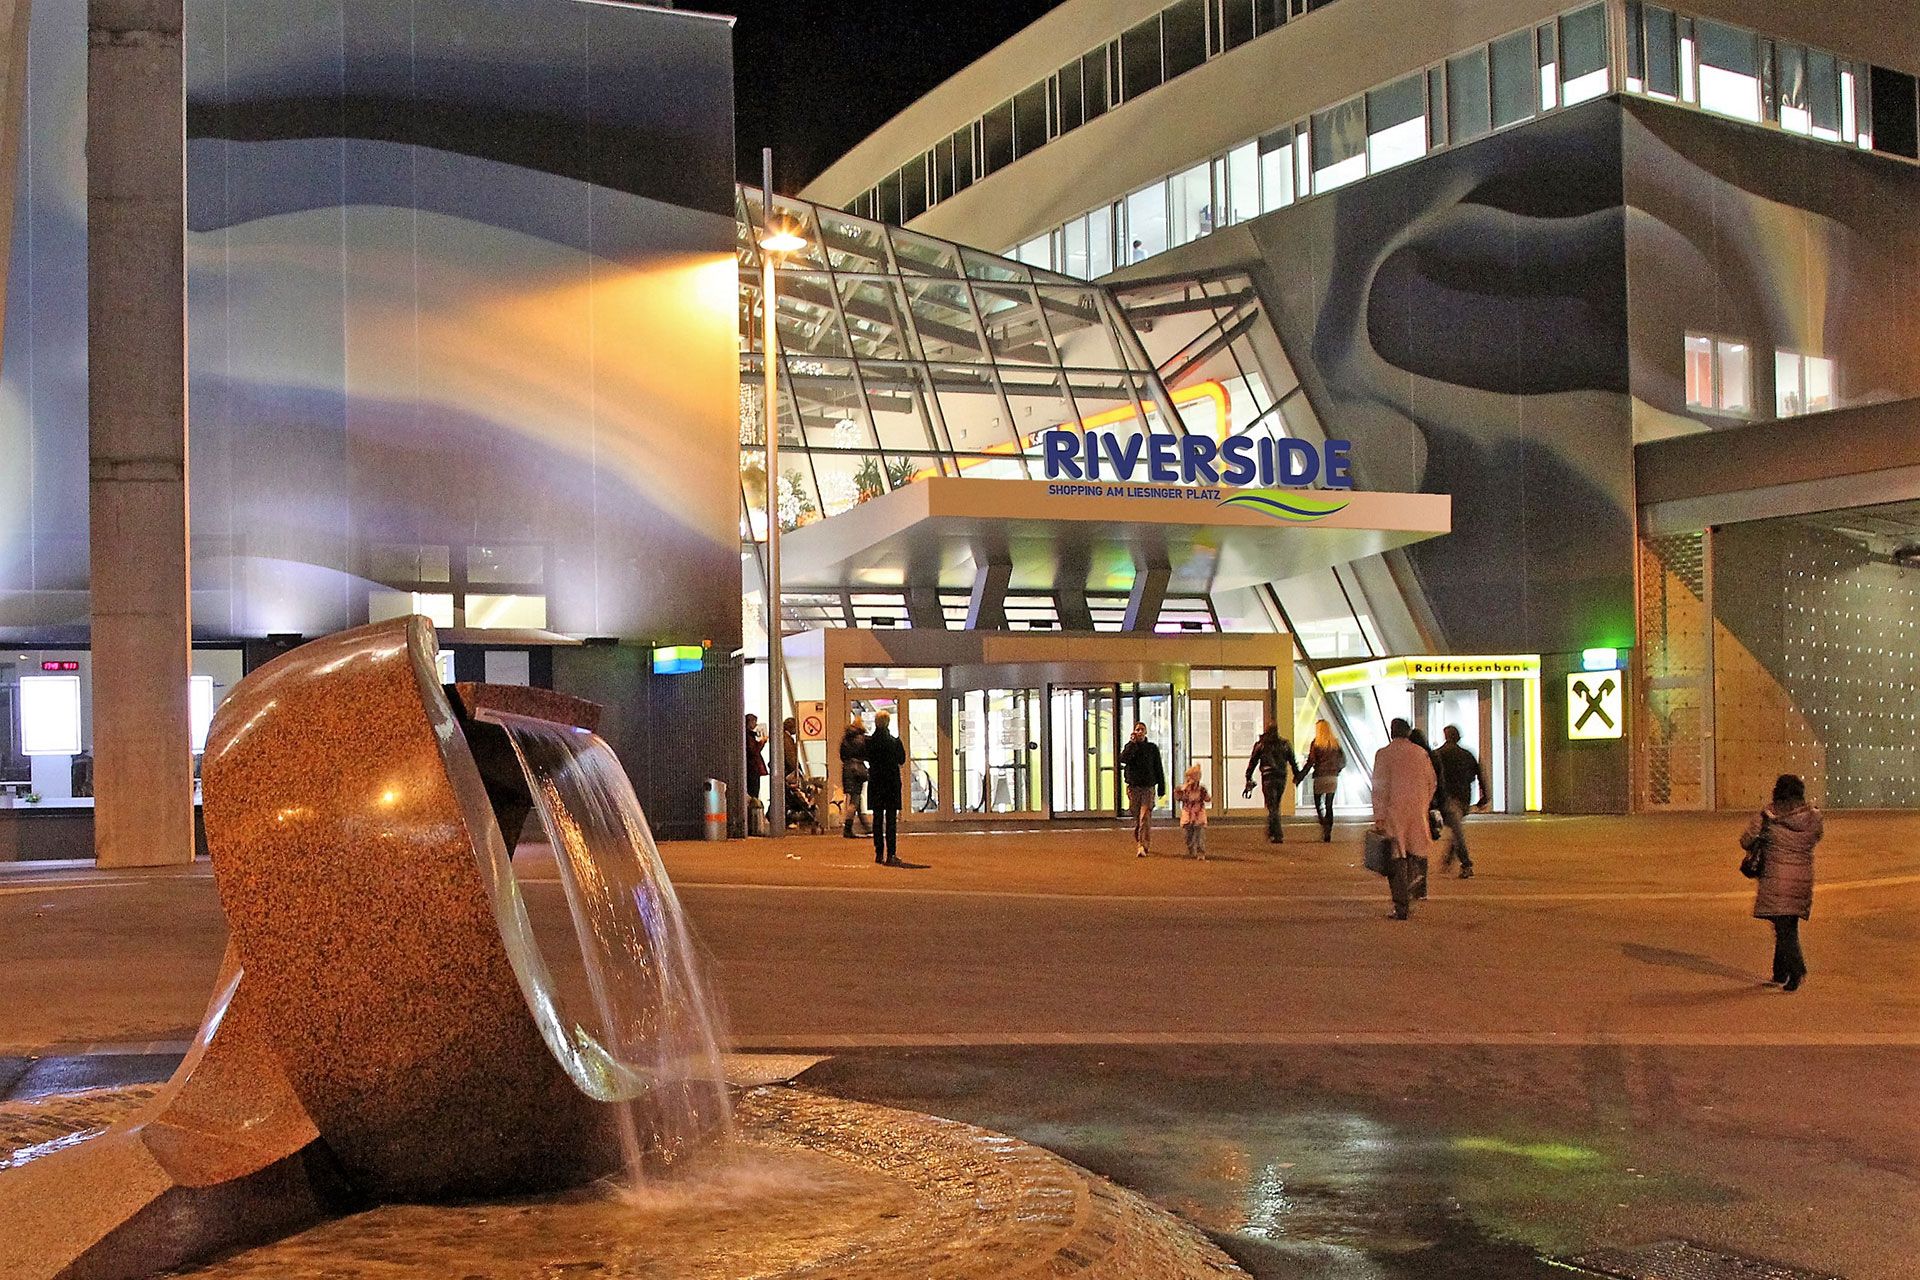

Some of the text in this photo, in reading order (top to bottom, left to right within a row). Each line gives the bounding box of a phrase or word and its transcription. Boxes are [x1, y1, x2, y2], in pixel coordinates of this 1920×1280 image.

[1044, 430, 1353, 487] RIVERSIDE
[1049, 484, 1221, 500] SHOPPING AM LIESINGER PLATZ
[1415, 663, 1529, 673] Raiffeisenbank
